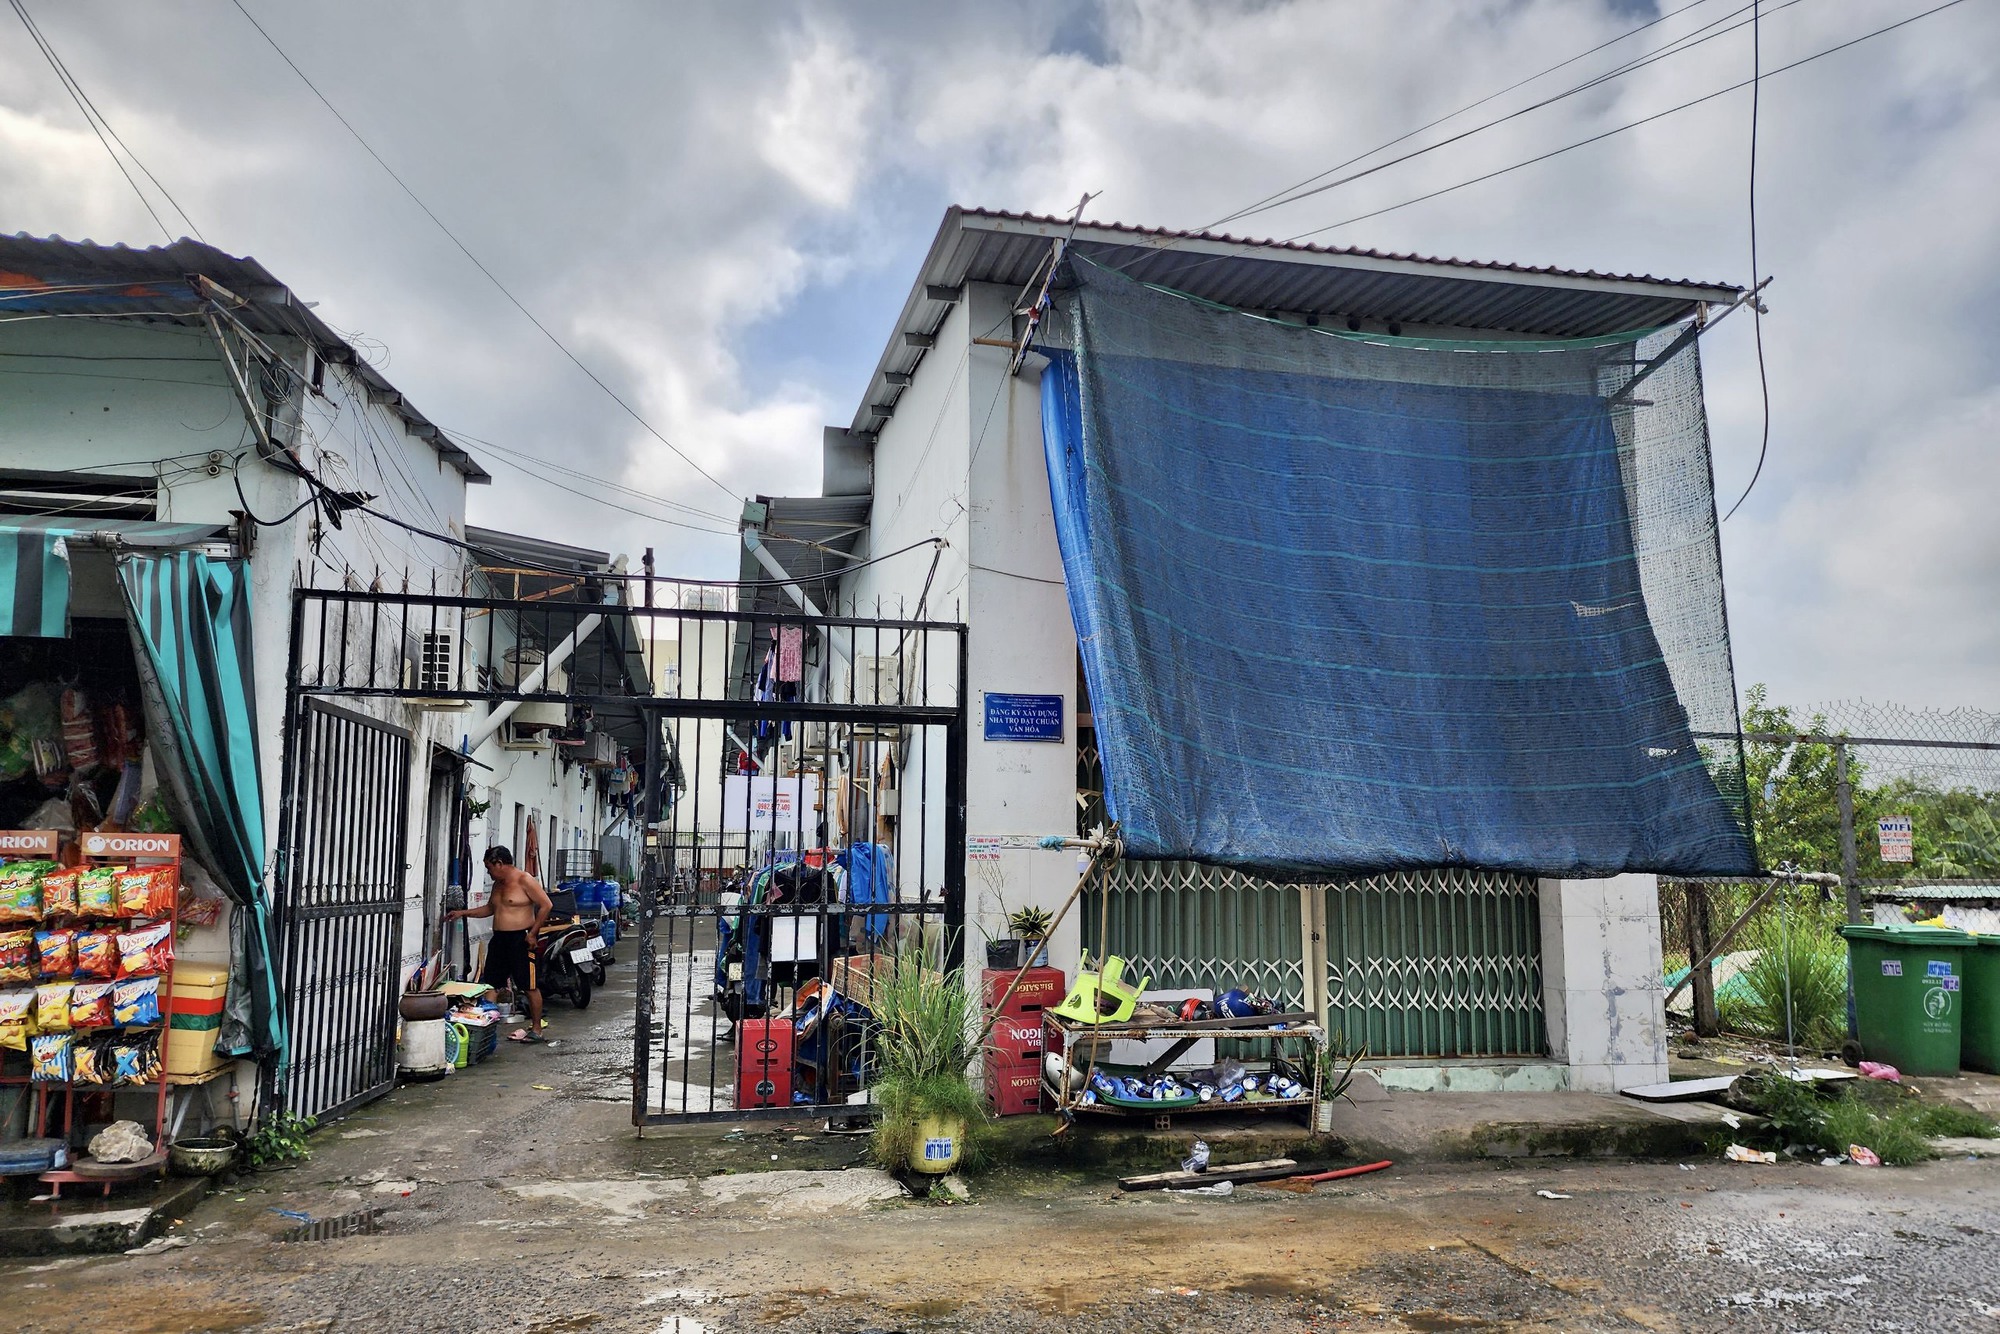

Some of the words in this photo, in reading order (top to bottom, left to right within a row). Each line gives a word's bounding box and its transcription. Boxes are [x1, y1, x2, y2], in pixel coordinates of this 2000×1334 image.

[1022, 708, 1038, 717] XÂY
[0, 836, 47, 849] RION
[110, 839, 169, 852] ORION
